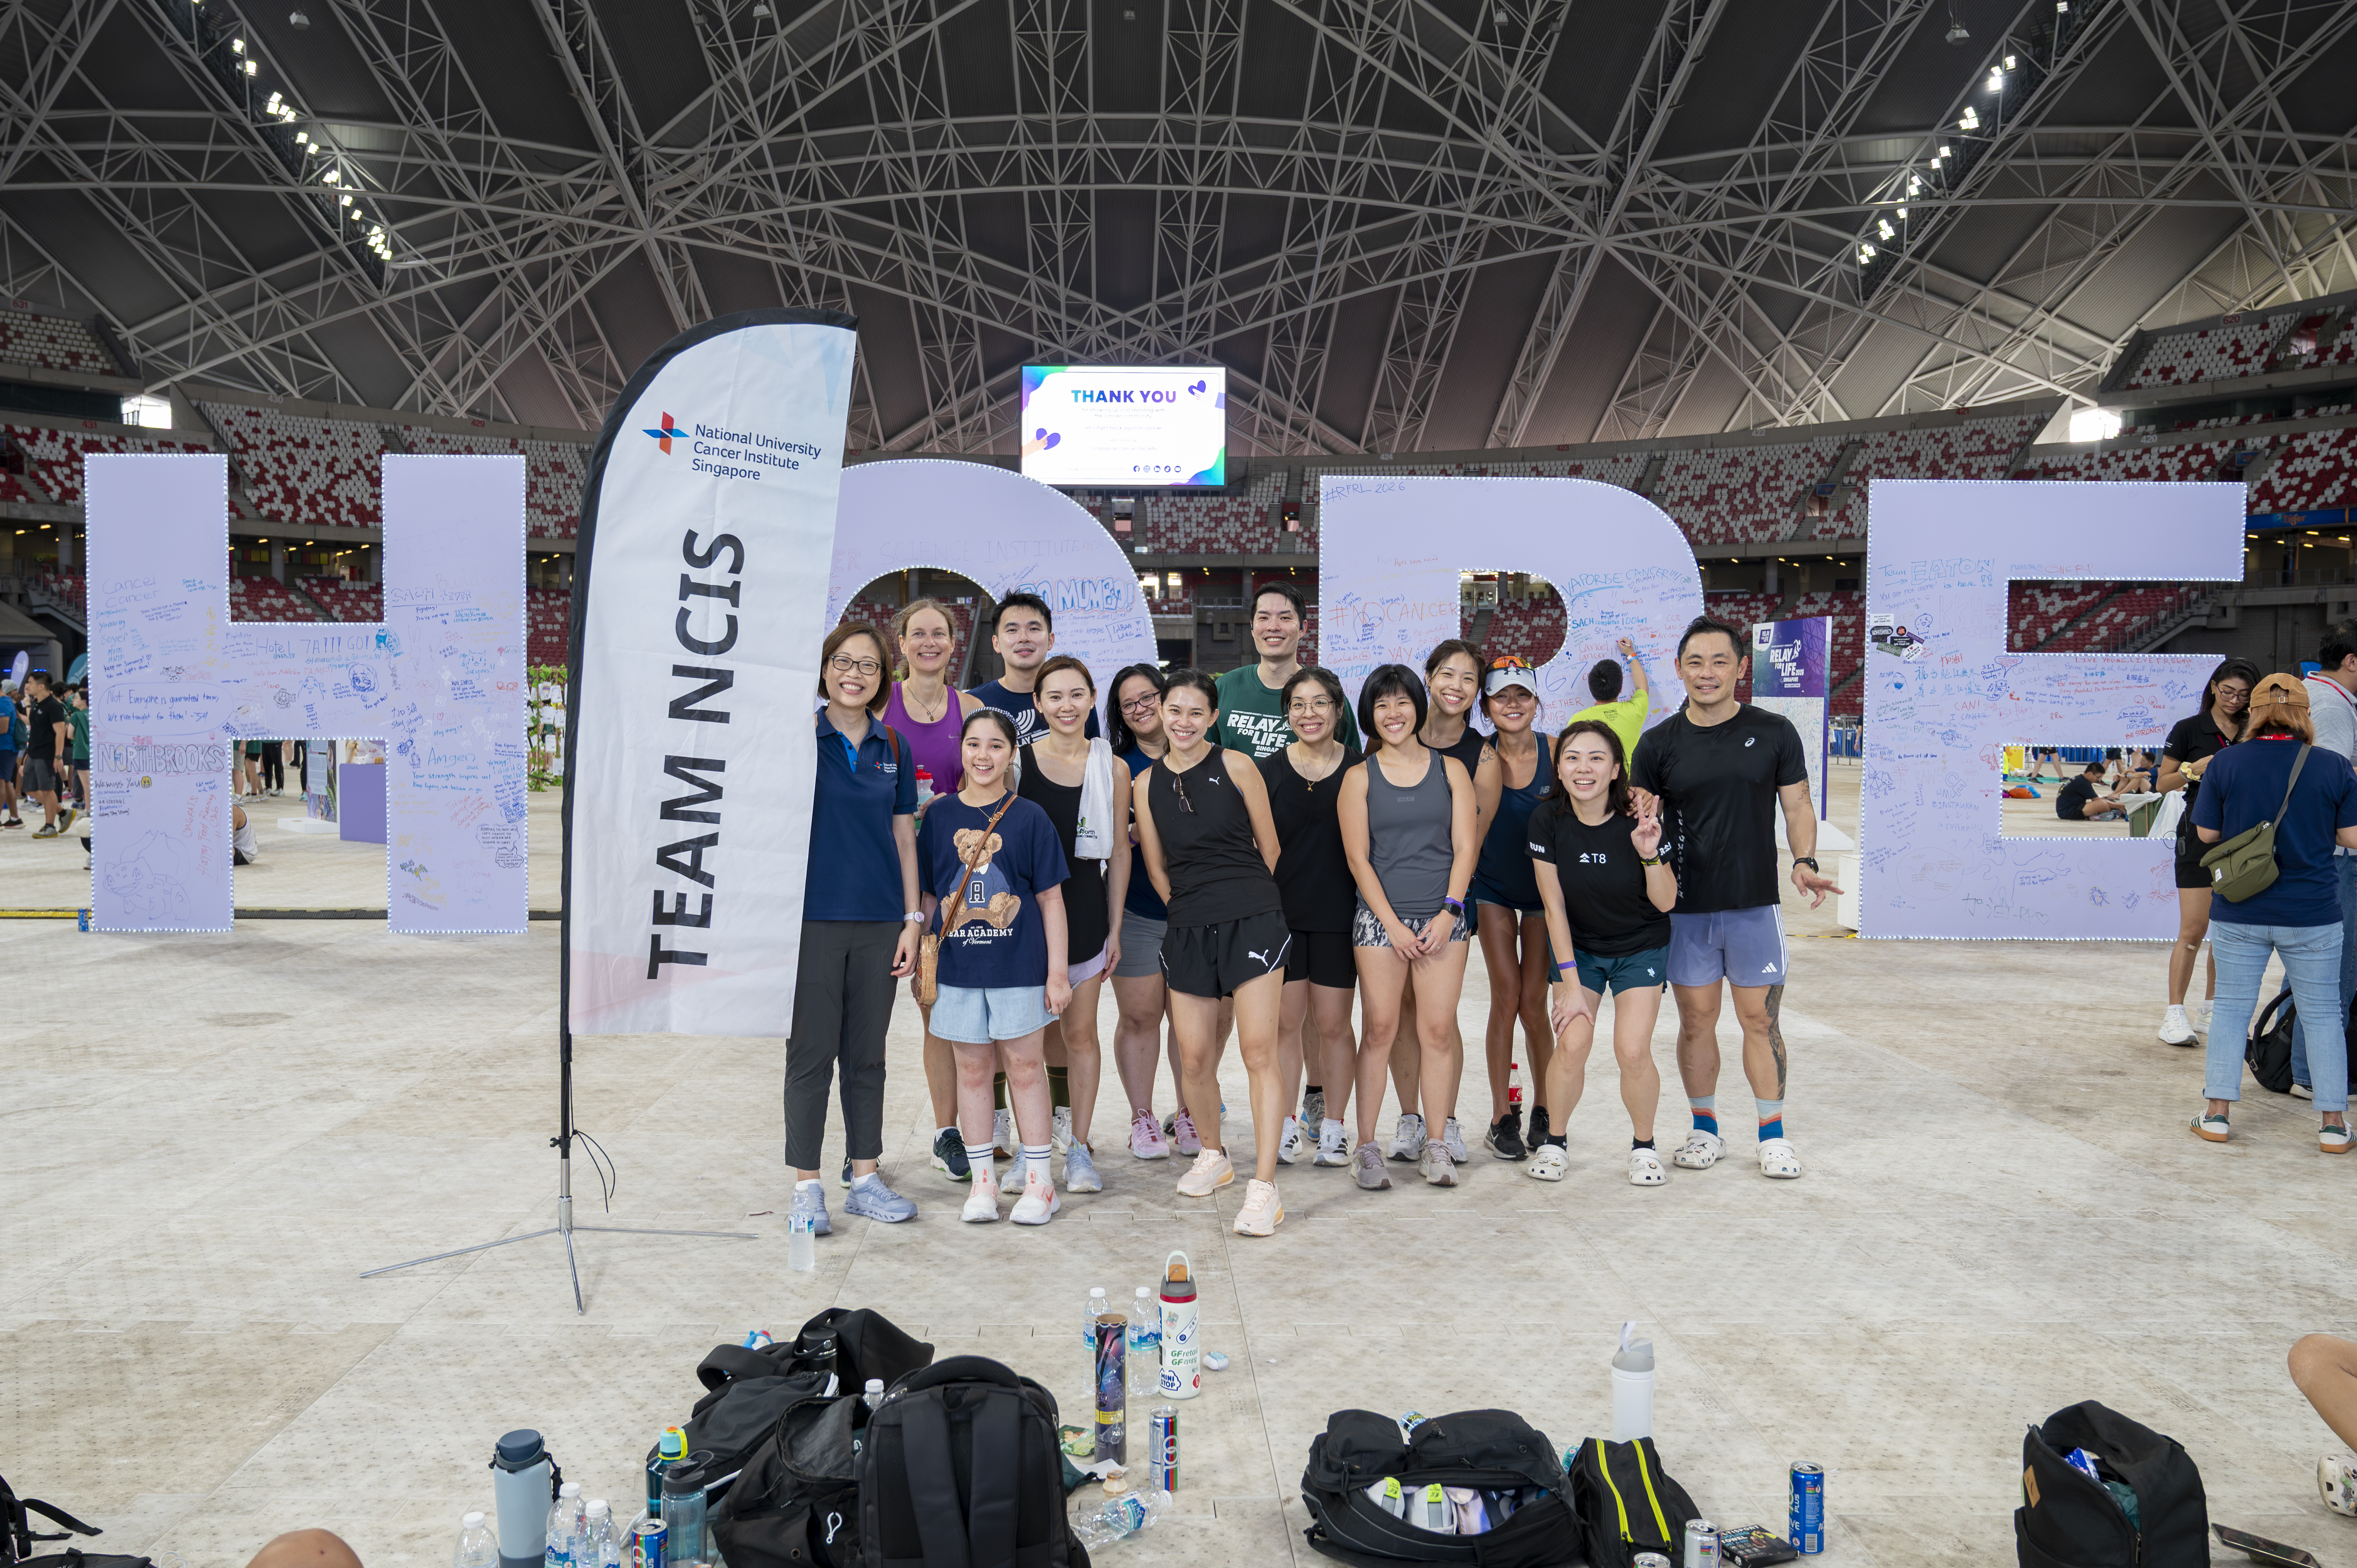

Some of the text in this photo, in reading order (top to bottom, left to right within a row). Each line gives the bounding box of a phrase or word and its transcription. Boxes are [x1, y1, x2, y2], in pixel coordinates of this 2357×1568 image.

[13, 299, 28, 309] 631
[2223, 315, 2240, 325] 620
[268, 395, 283, 404] 430
[1071, 390, 1176, 403] THANK YOU
[82, 421, 97, 429] 431
[696, 424, 821, 460] National University
[2140, 435, 2157, 443] 420
[694, 442, 799, 470] Cancer Institute
[692, 459, 760, 480] Singapore
[1375, 482, 1405, 496] 2026
[2283, 514, 2307, 525] Tiger
[880, 540, 1081, 565] SCIENCE INSTITUTE
[1878, 558, 1994, 585] Team EATON
[103, 571, 156, 594] Cancel
[1561, 573, 1624, 597] VAPORISE
[1635, 575, 1655, 584] MUMMY
[1057, 577, 1135, 613] MUMBO!
[1880, 593, 1890, 603] You
[1387, 602, 1458, 622] CANCER
[1572, 618, 1594, 629] SACH
[256, 638, 290, 656] Hotel
[1579, 640, 1608, 653] Cancel
[1389, 646, 1413, 665] YAY
[1770, 648, 1793, 663] RELAY
[1781, 662, 1796, 676] LIFE
[1094, 674, 1107, 684] Good
[107, 689, 199, 708] Not Everyone is guaranteed
[1954, 700, 1980, 711] CAN!
[1227, 714, 1281, 732] RELAY
[1016, 736, 1030, 747] LAY
[1252, 731, 1288, 748] LIFE
[98, 744, 225, 772] NORTHBROOKS
[428, 748, 476, 768] Amgen
[647, 529, 745, 979] TEAM NCIS
[1932, 801, 1979, 811] @INSTAGRAM
[1529, 841, 1545, 854] RUN
[1591, 853, 1606, 864] T8
[969, 881, 985, 903] A
[967, 929, 1013, 937] ACADEMY
[969, 937, 992, 945] Vermont
[1161, 1372, 1175, 1382] MINI
[1161, 1378, 1175, 1388] STOP
[1721, 1525, 1759, 1536] LTISPORT
